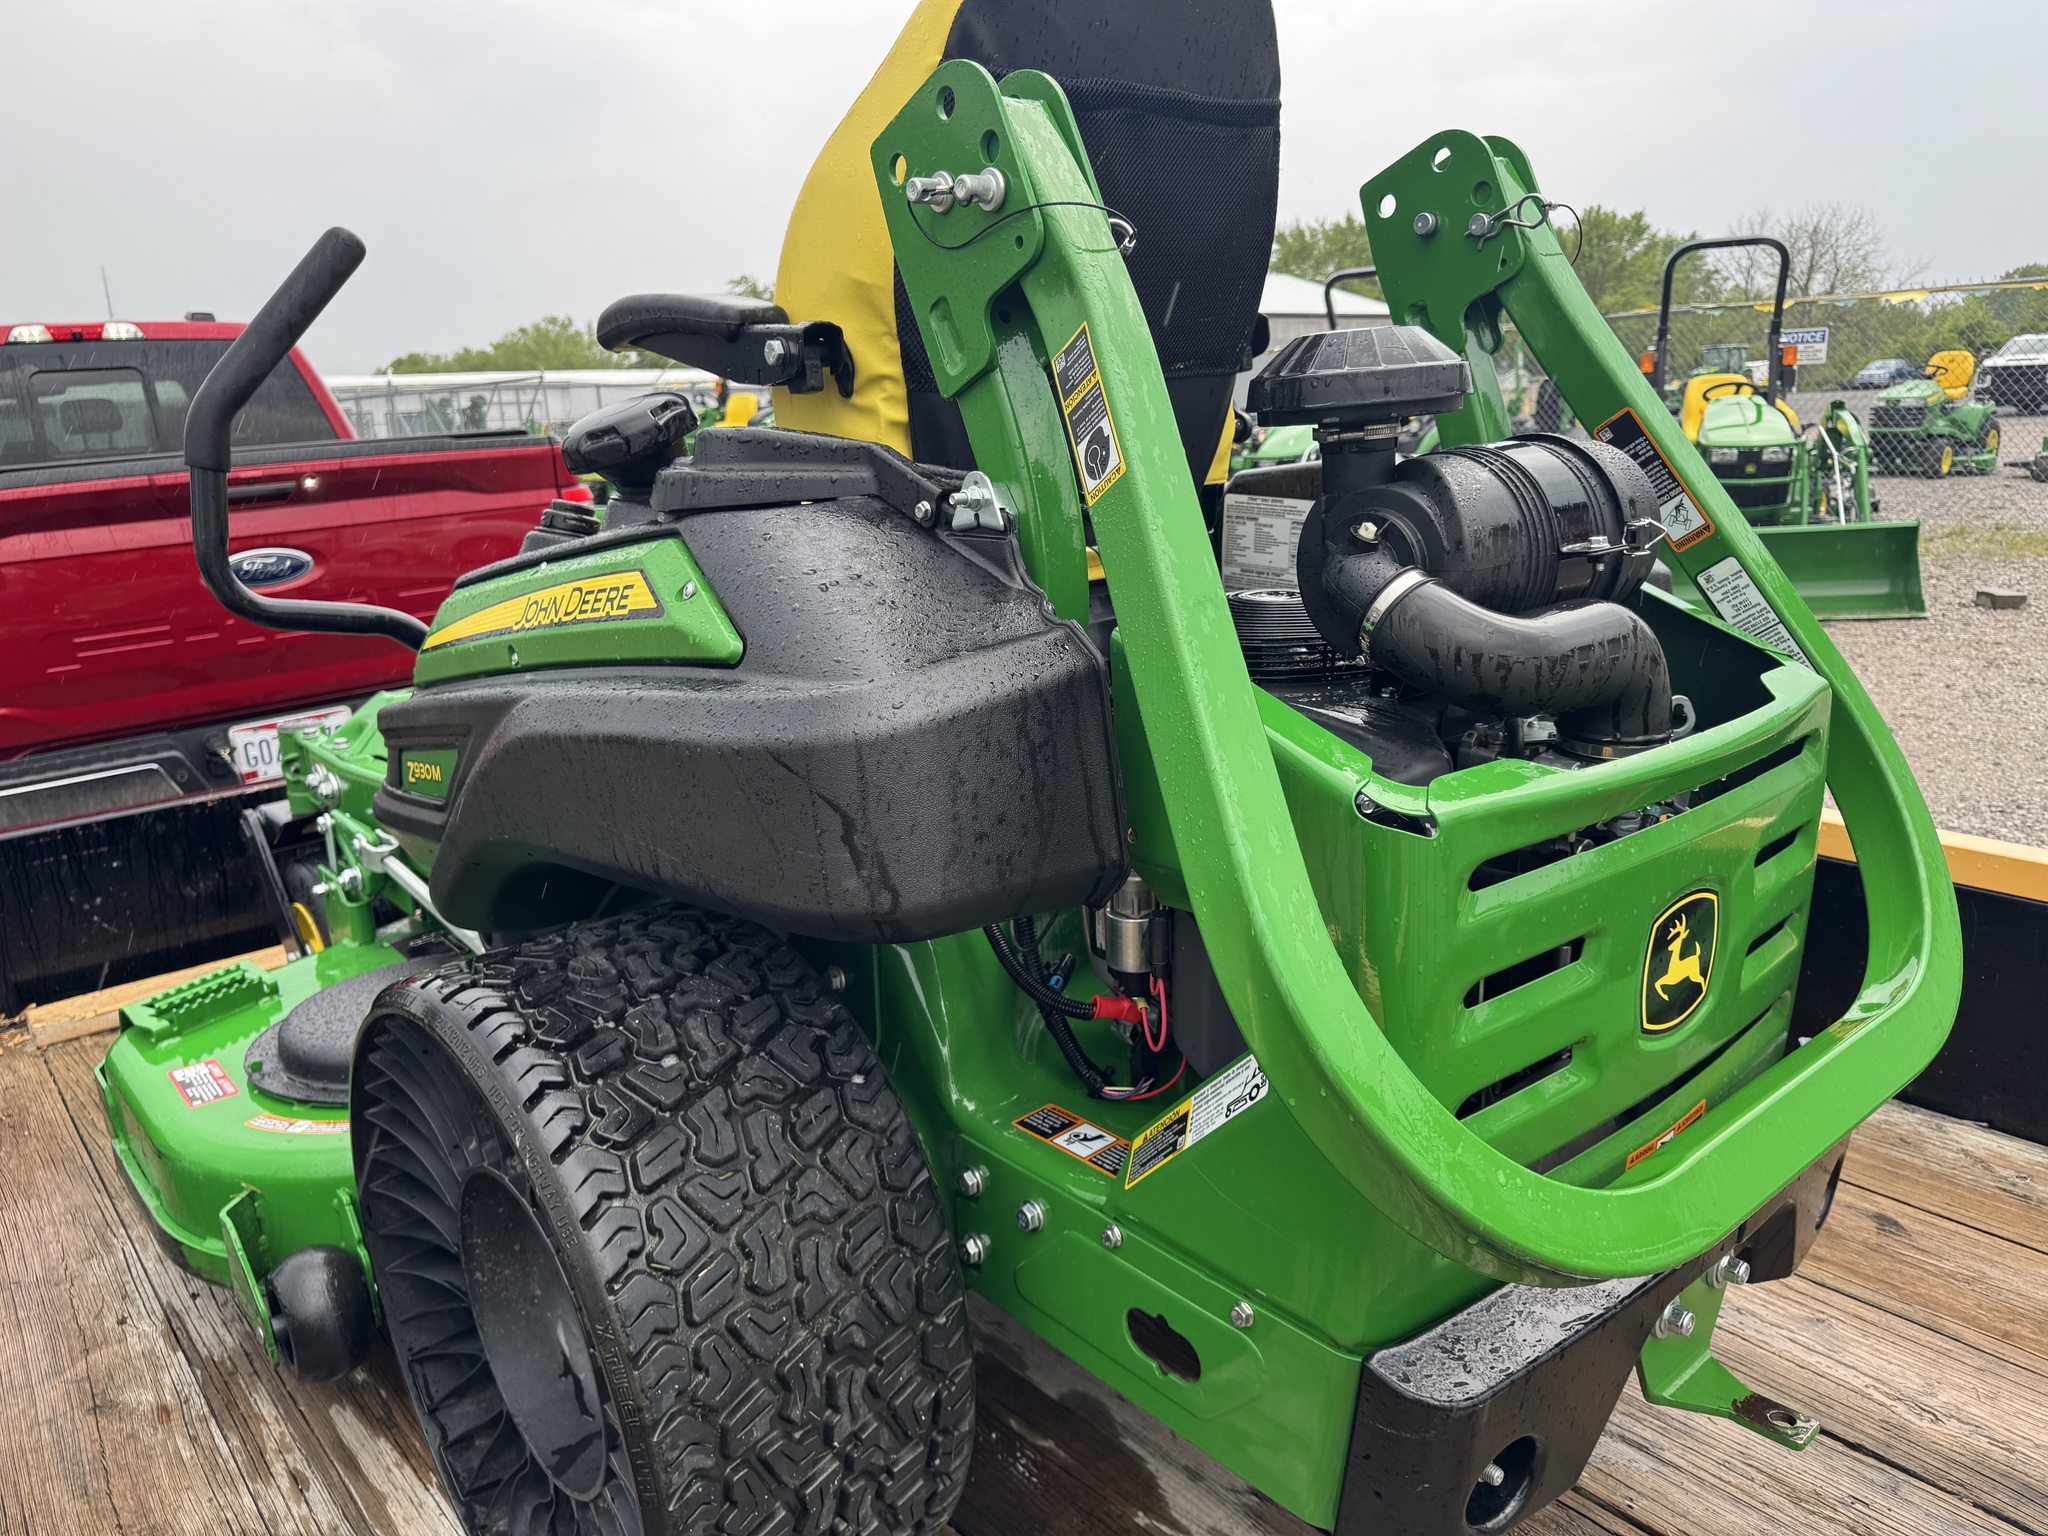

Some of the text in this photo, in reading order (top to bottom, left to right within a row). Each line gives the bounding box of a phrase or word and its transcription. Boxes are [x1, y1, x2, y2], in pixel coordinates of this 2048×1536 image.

[1064, 375, 1092, 413] ATENCIÓN
[1090, 469, 1117, 503] CAUTION
[1673, 526, 1706, 552] WARNING
[240, 556, 292, 580] Ford
[515, 583, 636, 626] JOHN DEERE
[406, 761, 442, 783] Z930M
[1149, 1105, 1181, 1138] ATENCIÓN
[505, 1110, 527, 1143] FOR
[520, 1142, 563, 1212] HIGHWAY
[556, 1214, 580, 1250] USE
